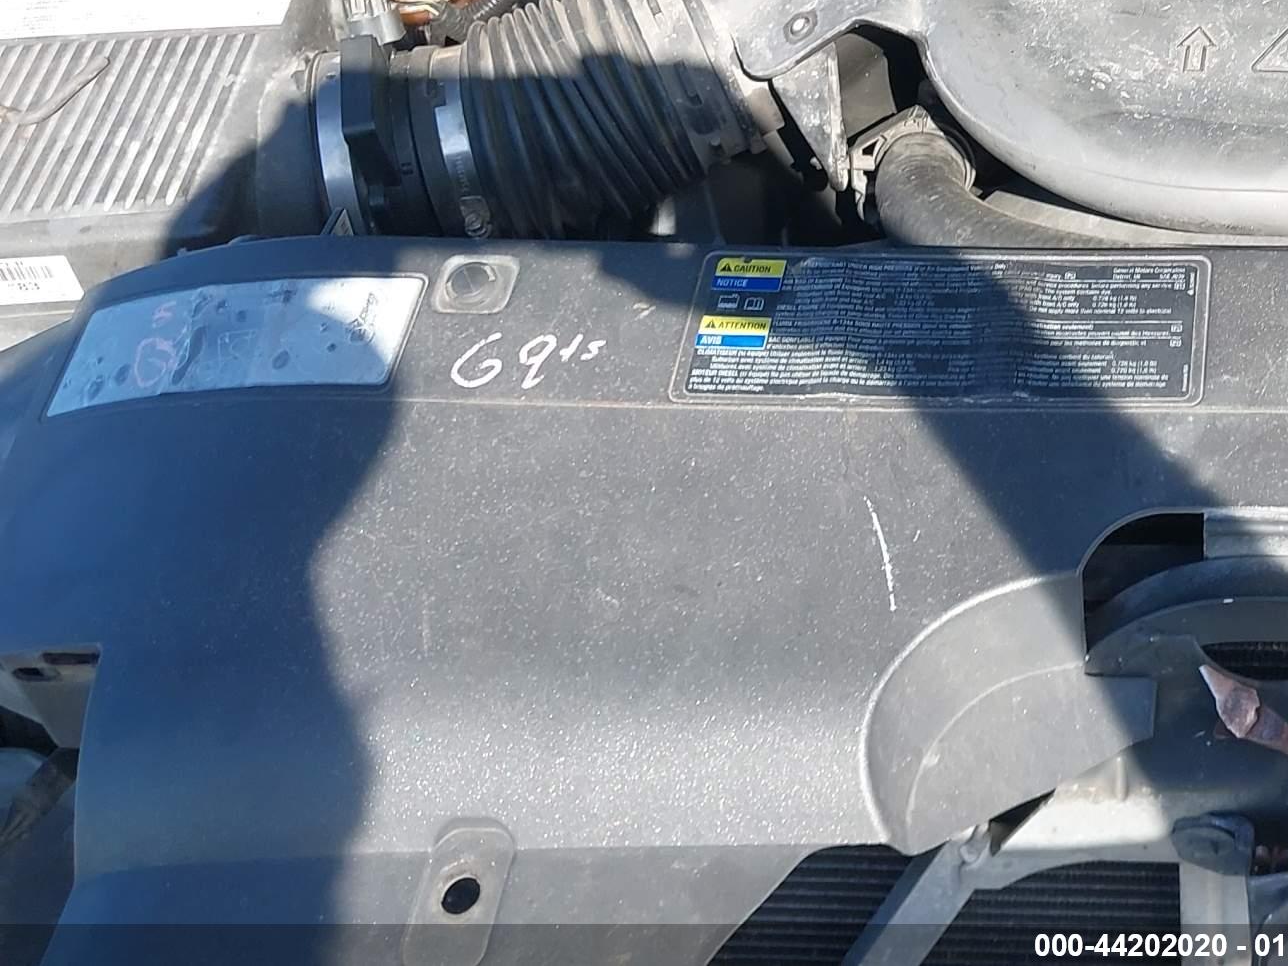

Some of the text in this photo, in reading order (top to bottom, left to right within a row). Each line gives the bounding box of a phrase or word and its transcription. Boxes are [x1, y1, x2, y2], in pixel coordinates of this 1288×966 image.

[733, 264, 771, 274] CAUTION
[716, 278, 749, 288] NOTICE
[718, 320, 766, 331] ATTENTION
[699, 336, 722, 345] AVIS
